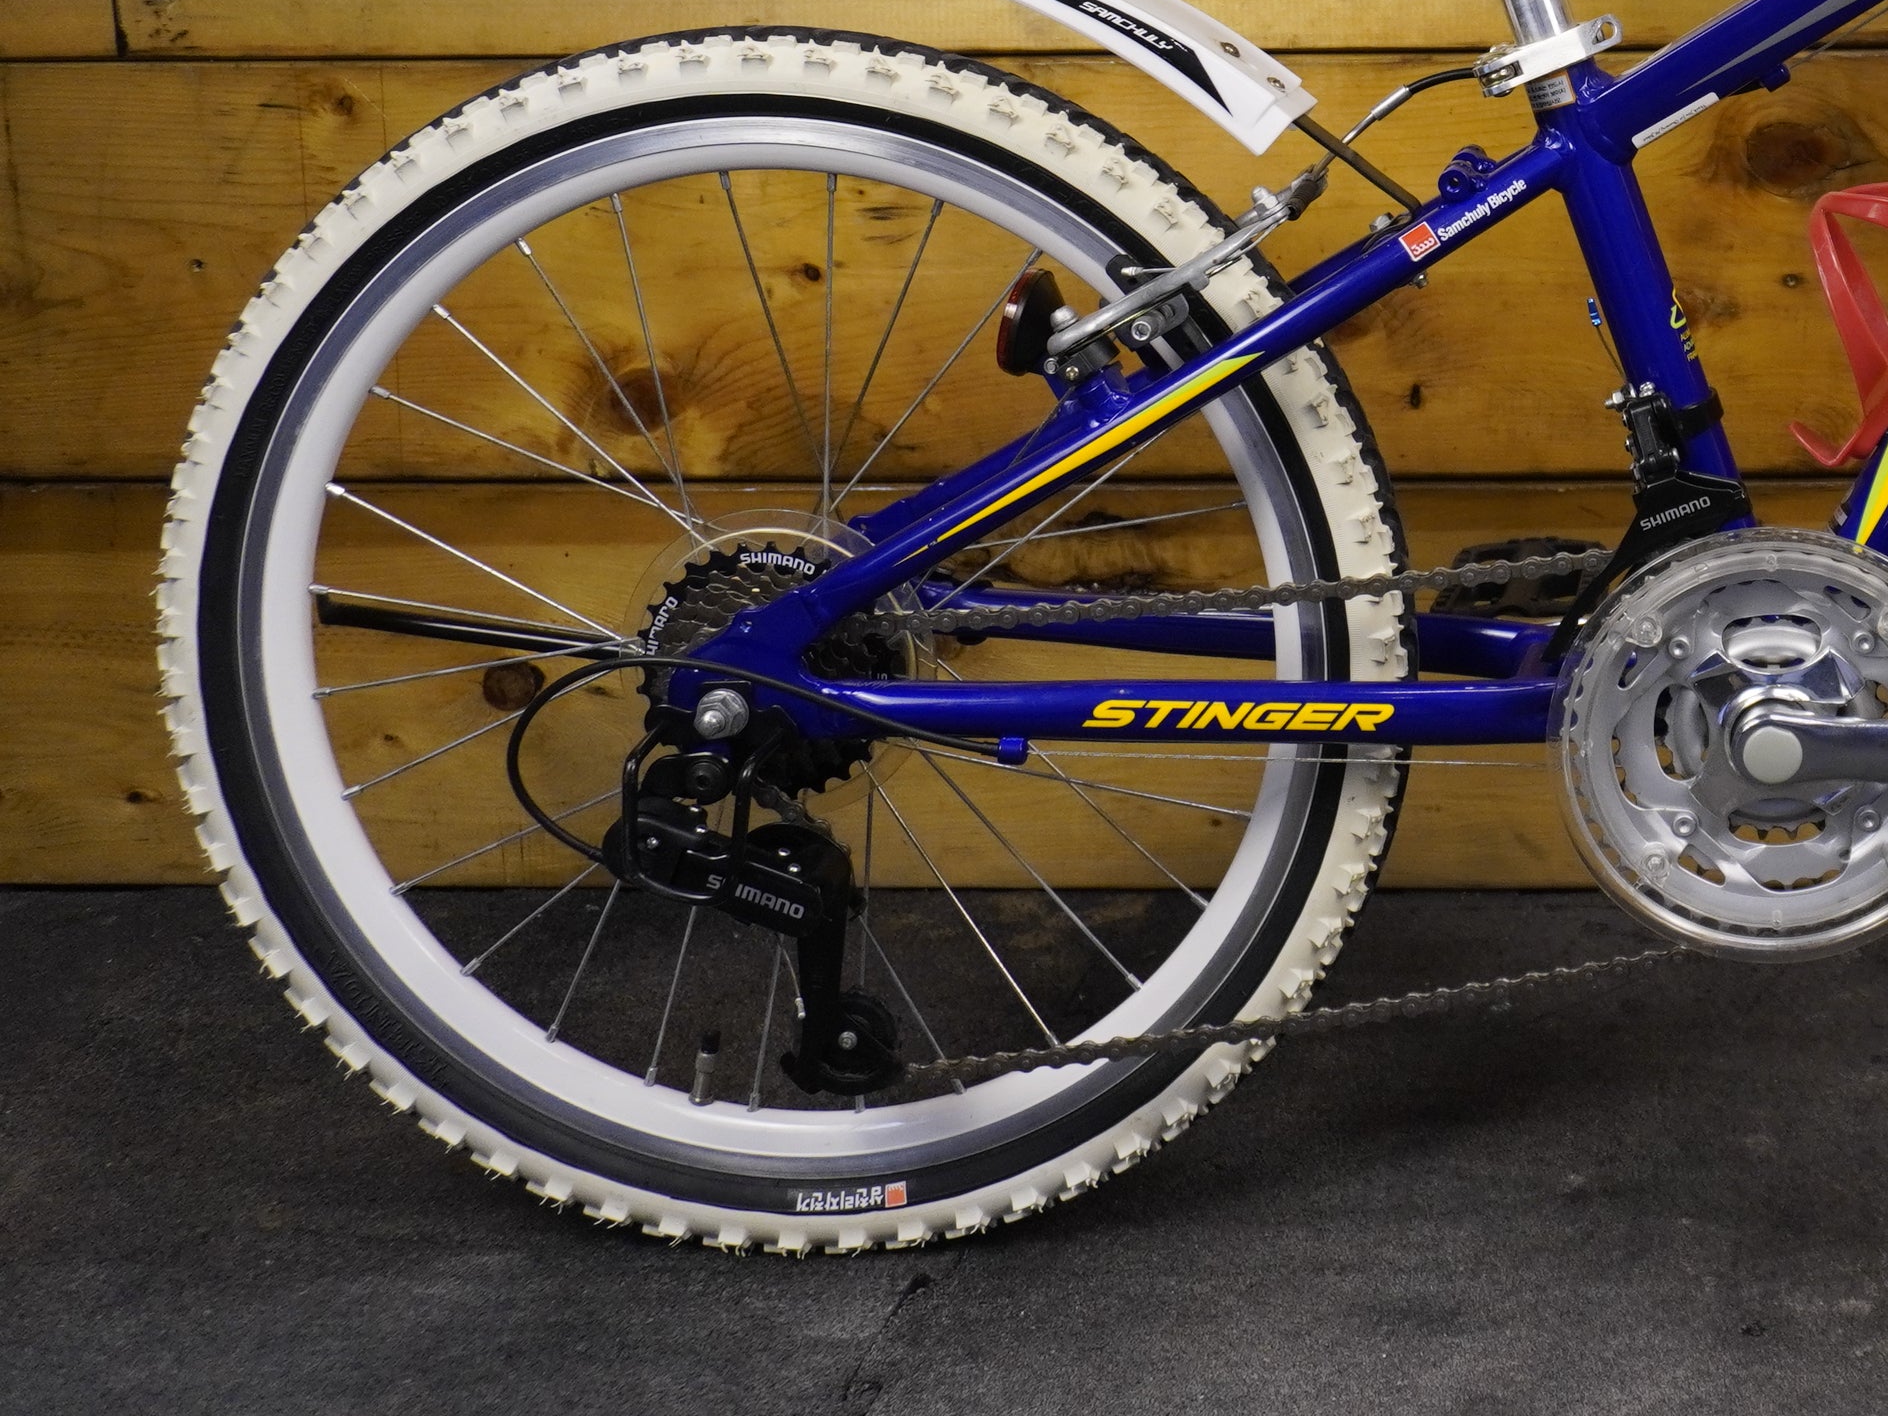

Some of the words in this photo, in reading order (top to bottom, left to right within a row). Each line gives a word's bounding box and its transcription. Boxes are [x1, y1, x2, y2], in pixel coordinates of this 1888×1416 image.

[1079, 1, 1173, 50] SAMCHULY
[1437, 203, 1491, 242] Samchuly
[1487, 179, 1527, 209] Bicycle
[1640, 496, 1711, 532] SHIMANO
[740, 552, 815, 575] SHIMANO
[646, 596, 679, 656] HIMANO
[1081, 699, 1395, 732] STINGER
[706, 874, 805, 920] SIMANO
[796, 1186, 884, 1212] 삼천리자전거
